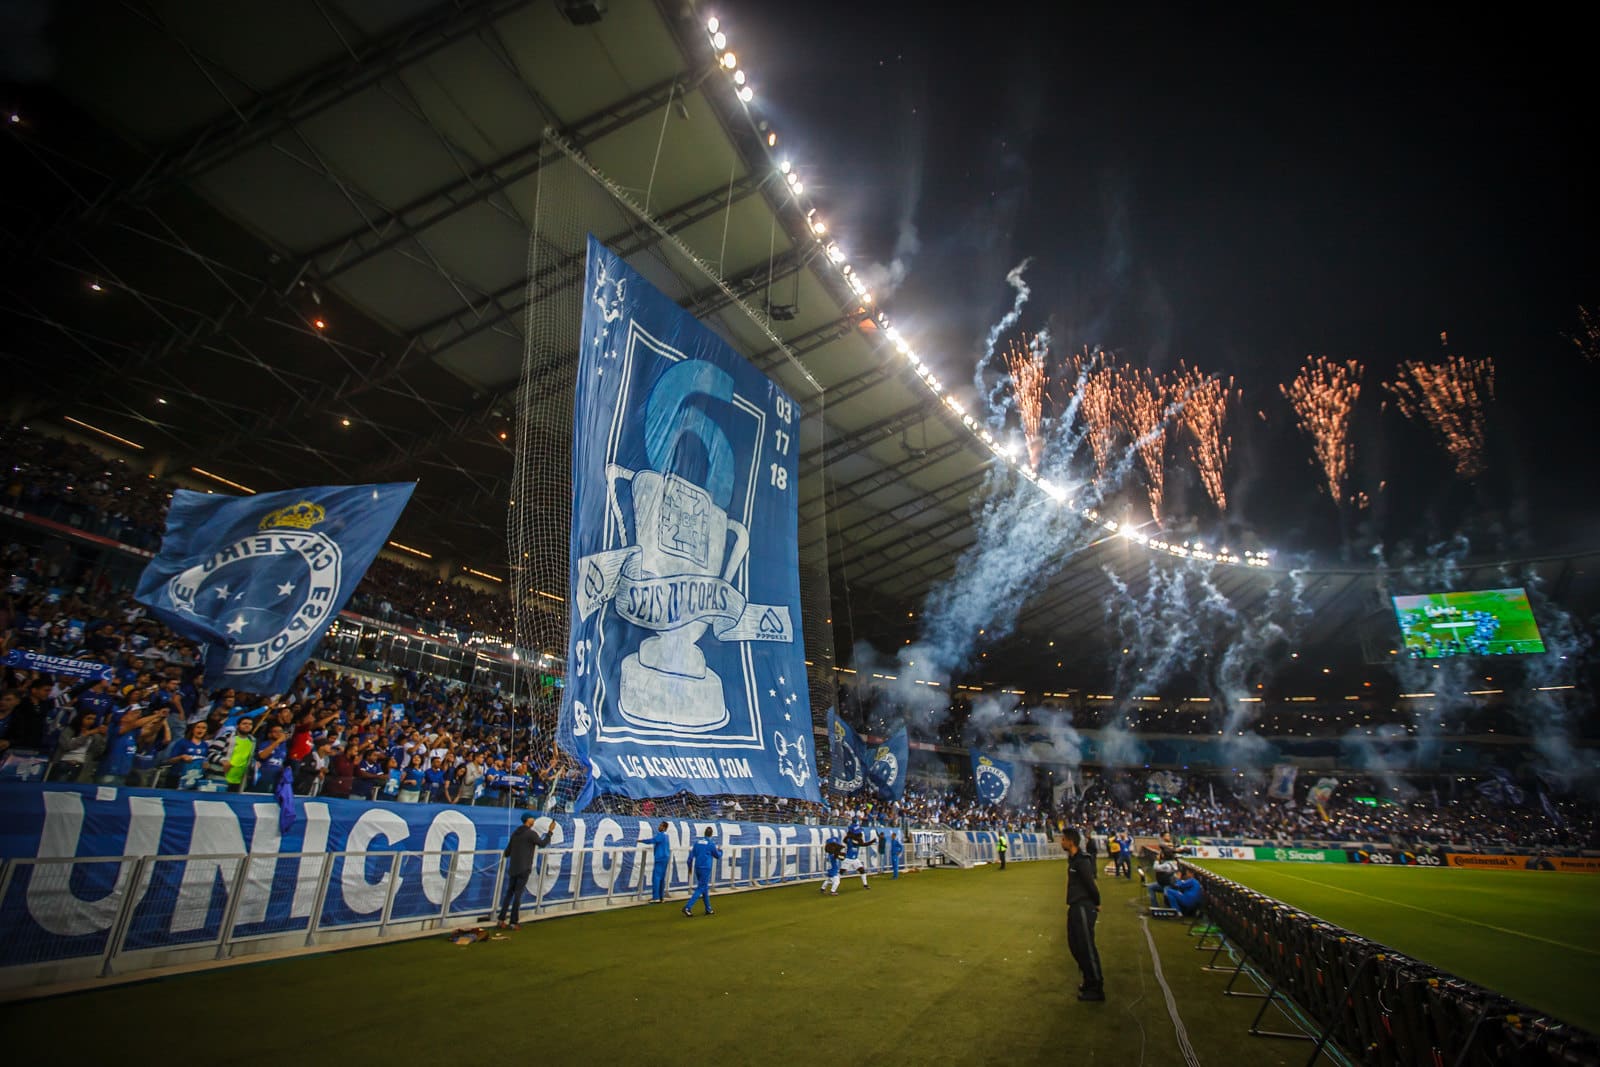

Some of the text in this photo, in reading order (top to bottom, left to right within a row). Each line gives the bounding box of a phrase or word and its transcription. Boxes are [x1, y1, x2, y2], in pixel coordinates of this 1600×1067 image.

[775, 395, 792, 425] 03
[775, 429, 790, 456] 17
[770, 462, 788, 491] 18
[627, 584, 664, 623] SEIS
[688, 581, 729, 614] COPAS
[24, 652, 104, 671] CRUZEIRO
[758, 825, 802, 879] DE
[1218, 847, 1233, 858] Sil
[1288, 850, 1325, 861] Sicredi
[1454, 855, 1508, 867] Continental
